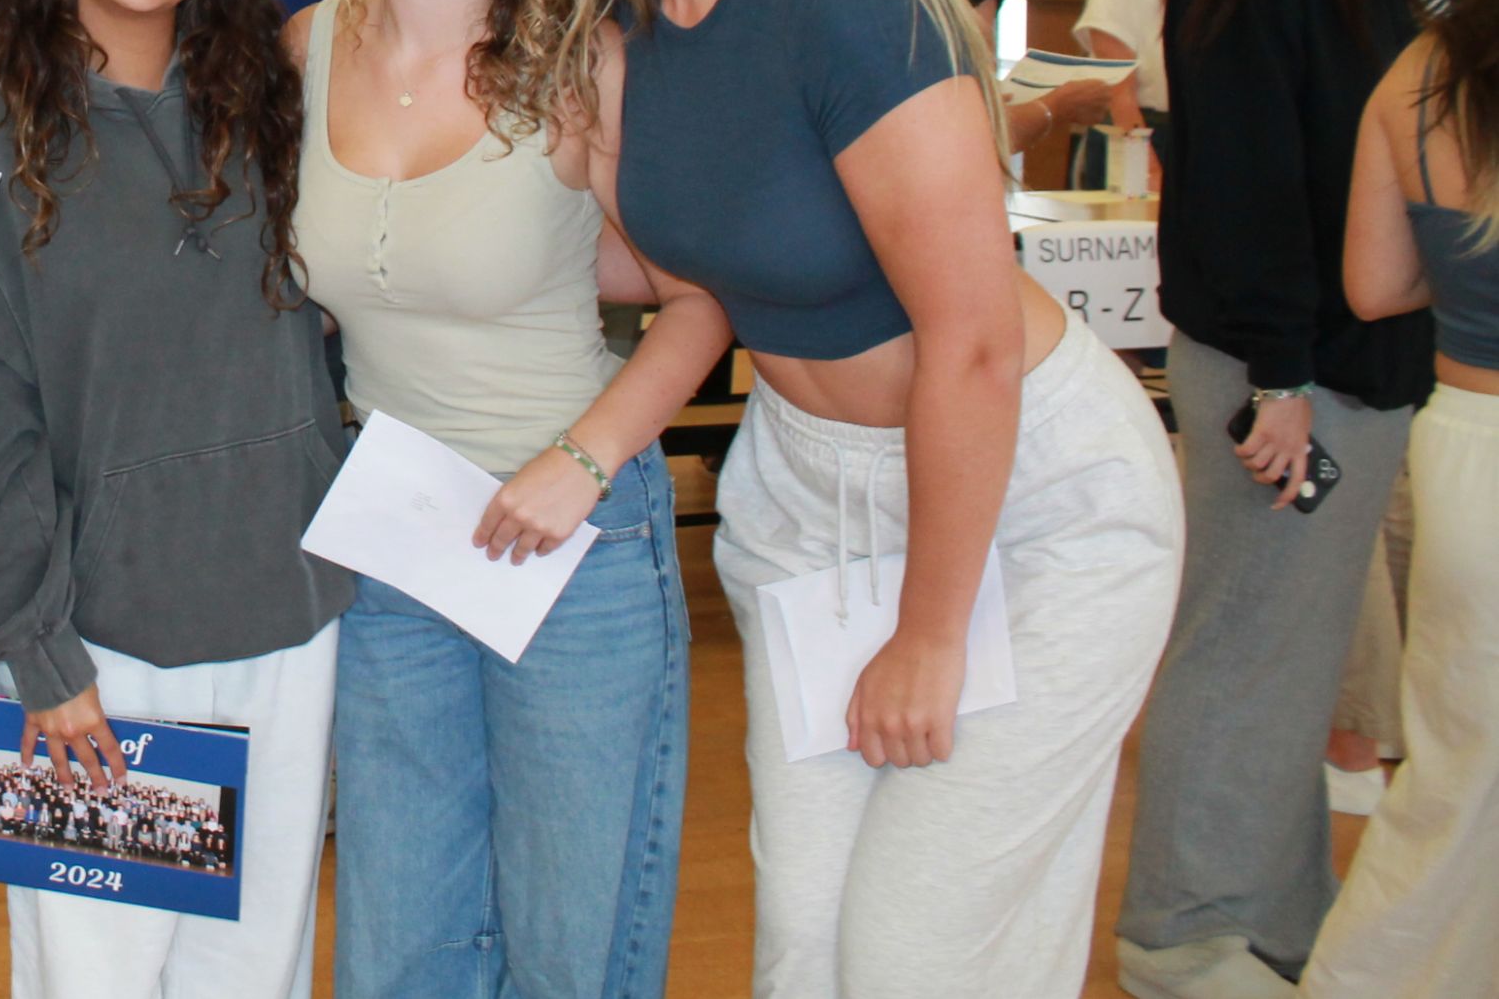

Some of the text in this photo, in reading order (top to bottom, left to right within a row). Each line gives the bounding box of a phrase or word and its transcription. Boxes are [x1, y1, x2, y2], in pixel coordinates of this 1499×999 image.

[1038, 235, 1156, 263] SURNAM
[1068, 290, 1089, 323] R
[1123, 288, 1145, 321] Z
[120, 733, 154, 766] of
[49, 860, 124, 892] 2024
